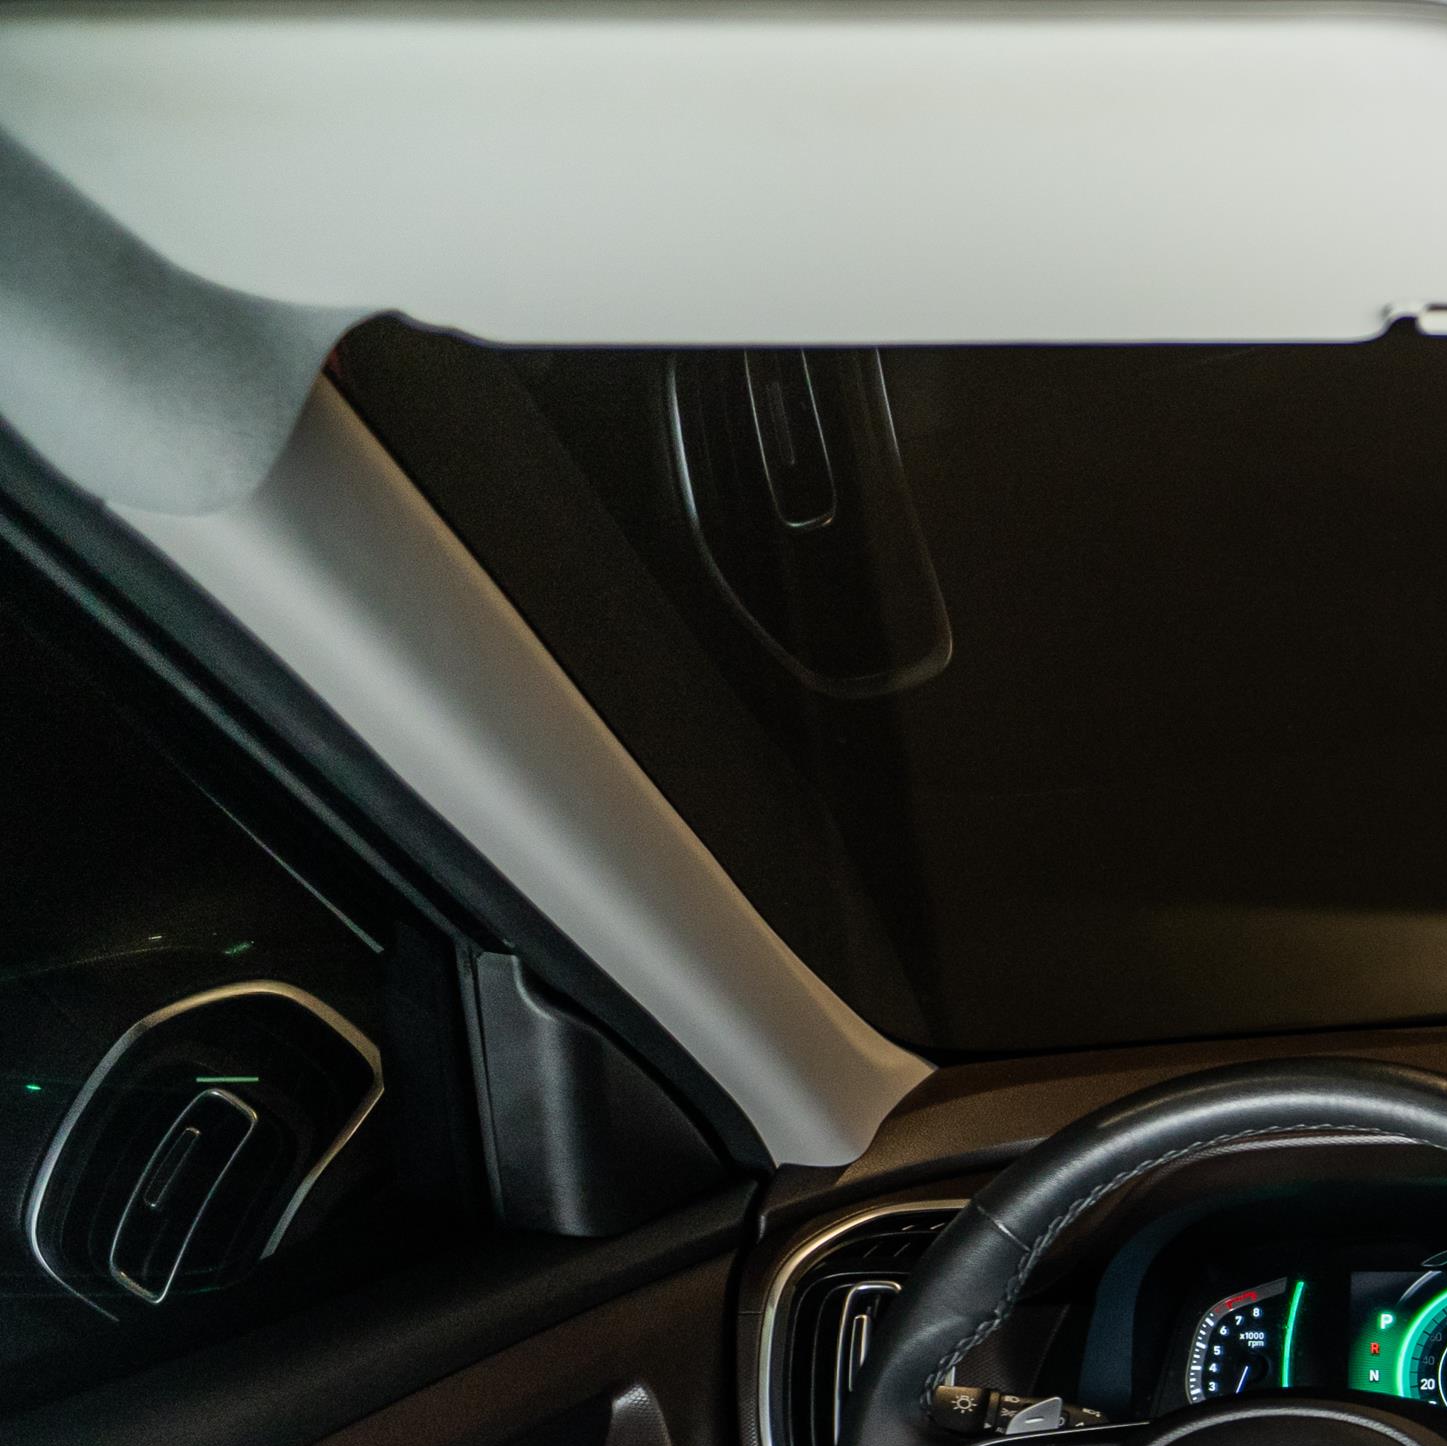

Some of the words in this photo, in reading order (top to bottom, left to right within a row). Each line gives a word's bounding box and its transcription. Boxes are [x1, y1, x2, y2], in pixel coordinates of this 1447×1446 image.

[1253, 1308, 1260, 1317] 8
[1235, 1315, 1243, 1325] 7
[1380, 1313, 1393, 1329] P
[1220, 1326, 1228, 1335] 6
[1240, 1332, 1265, 1340] x1000
[1248, 1340, 1264, 1348] rpm
[1370, 1343, 1380, 1354] R
[1213, 1345, 1221, 1355] 5
[1208, 1363, 1217, 1373] 4
[1369, 1370, 1379, 1382] N
[1208, 1382, 1216, 1391] 3
[1420, 1379, 1435, 1390] 20
